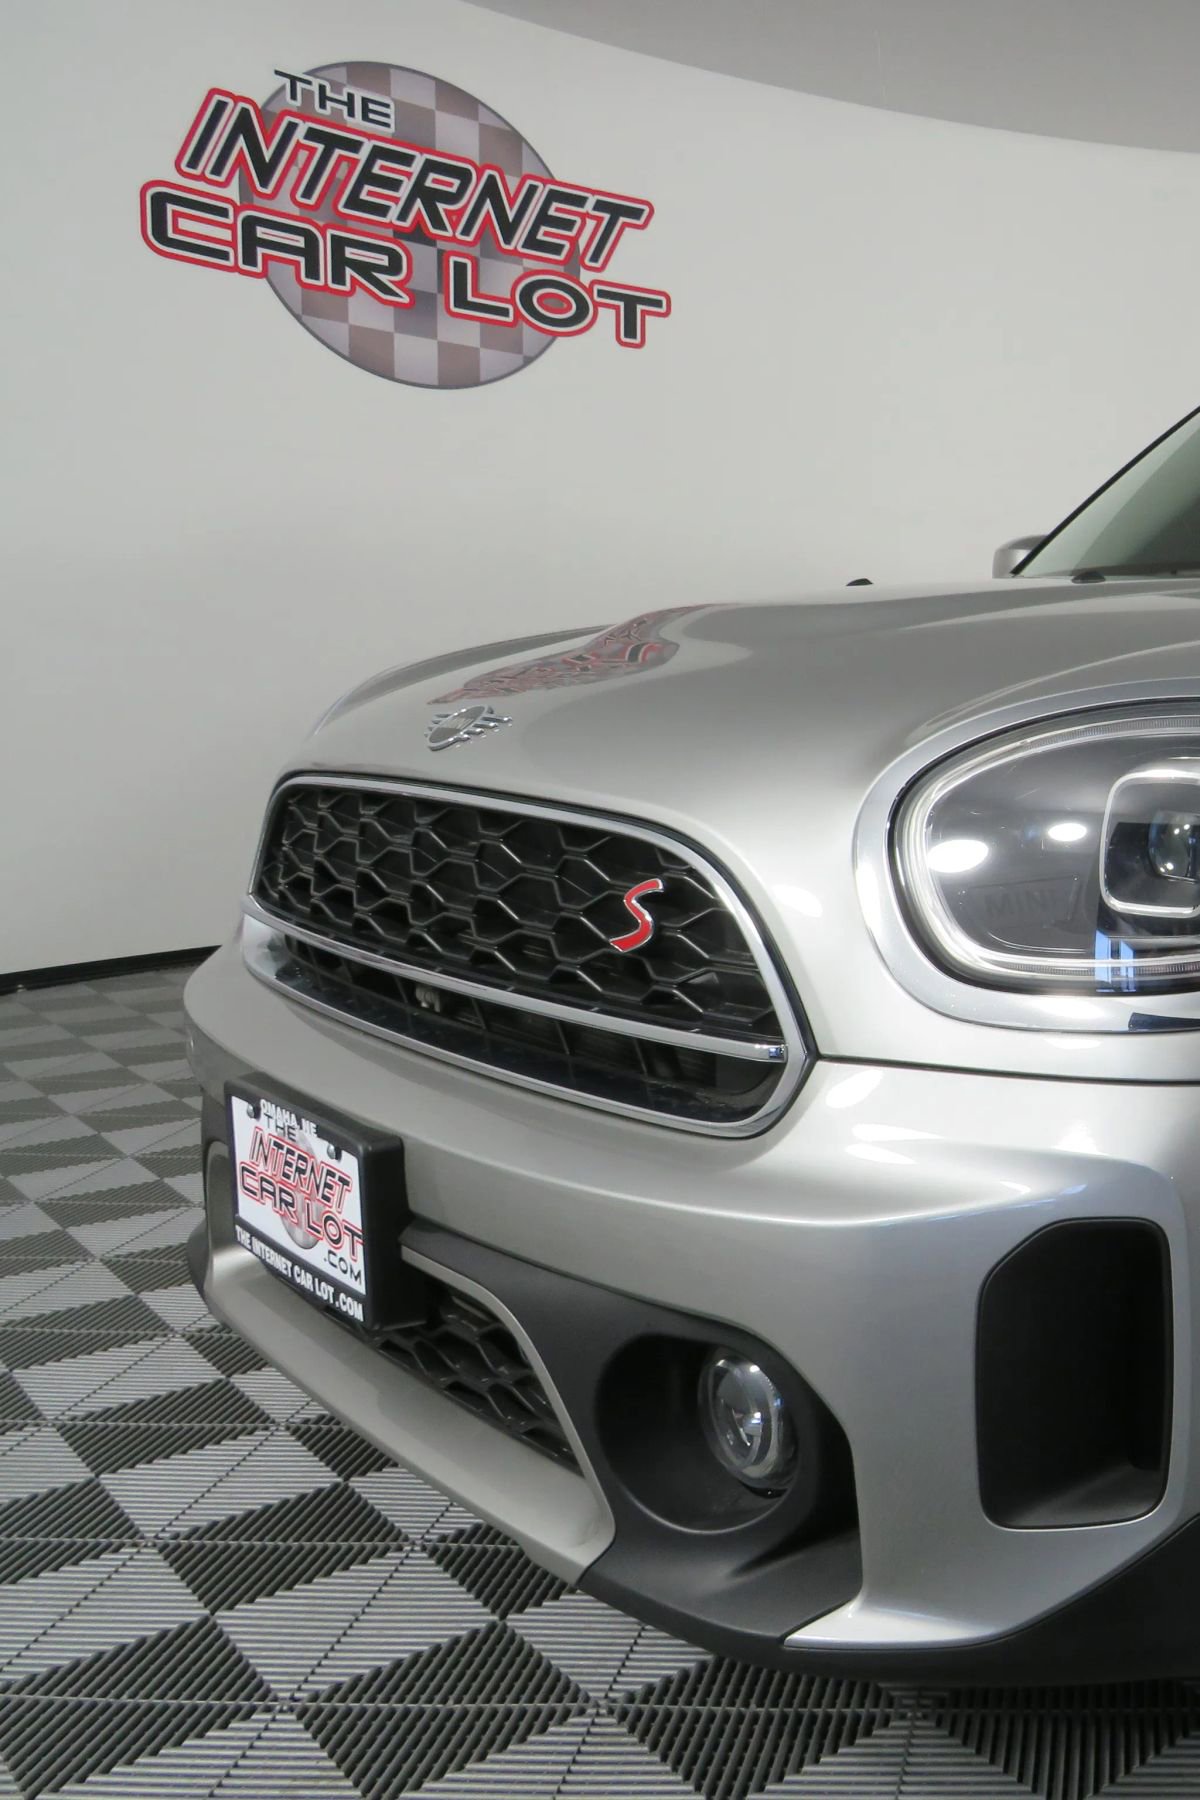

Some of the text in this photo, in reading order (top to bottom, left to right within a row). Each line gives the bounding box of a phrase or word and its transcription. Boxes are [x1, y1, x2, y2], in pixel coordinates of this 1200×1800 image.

[274, 69, 394, 129] THE
[180, 92, 652, 268] INTERNET
[145, 185, 668, 346] CAR LOT
[609, 878, 664, 953] S
[264, 1113, 297, 1142] THE
[250, 1127, 352, 1213] INTERNET
[240, 1163, 364, 1260] CAR LOT
[235, 1224, 252, 1250] THE
[252, 1236, 293, 1277] INTERNET
[293, 1265, 314, 1292] CAR
[314, 1277, 335, 1304] LOT
[323, 1250, 363, 1287] .COM
